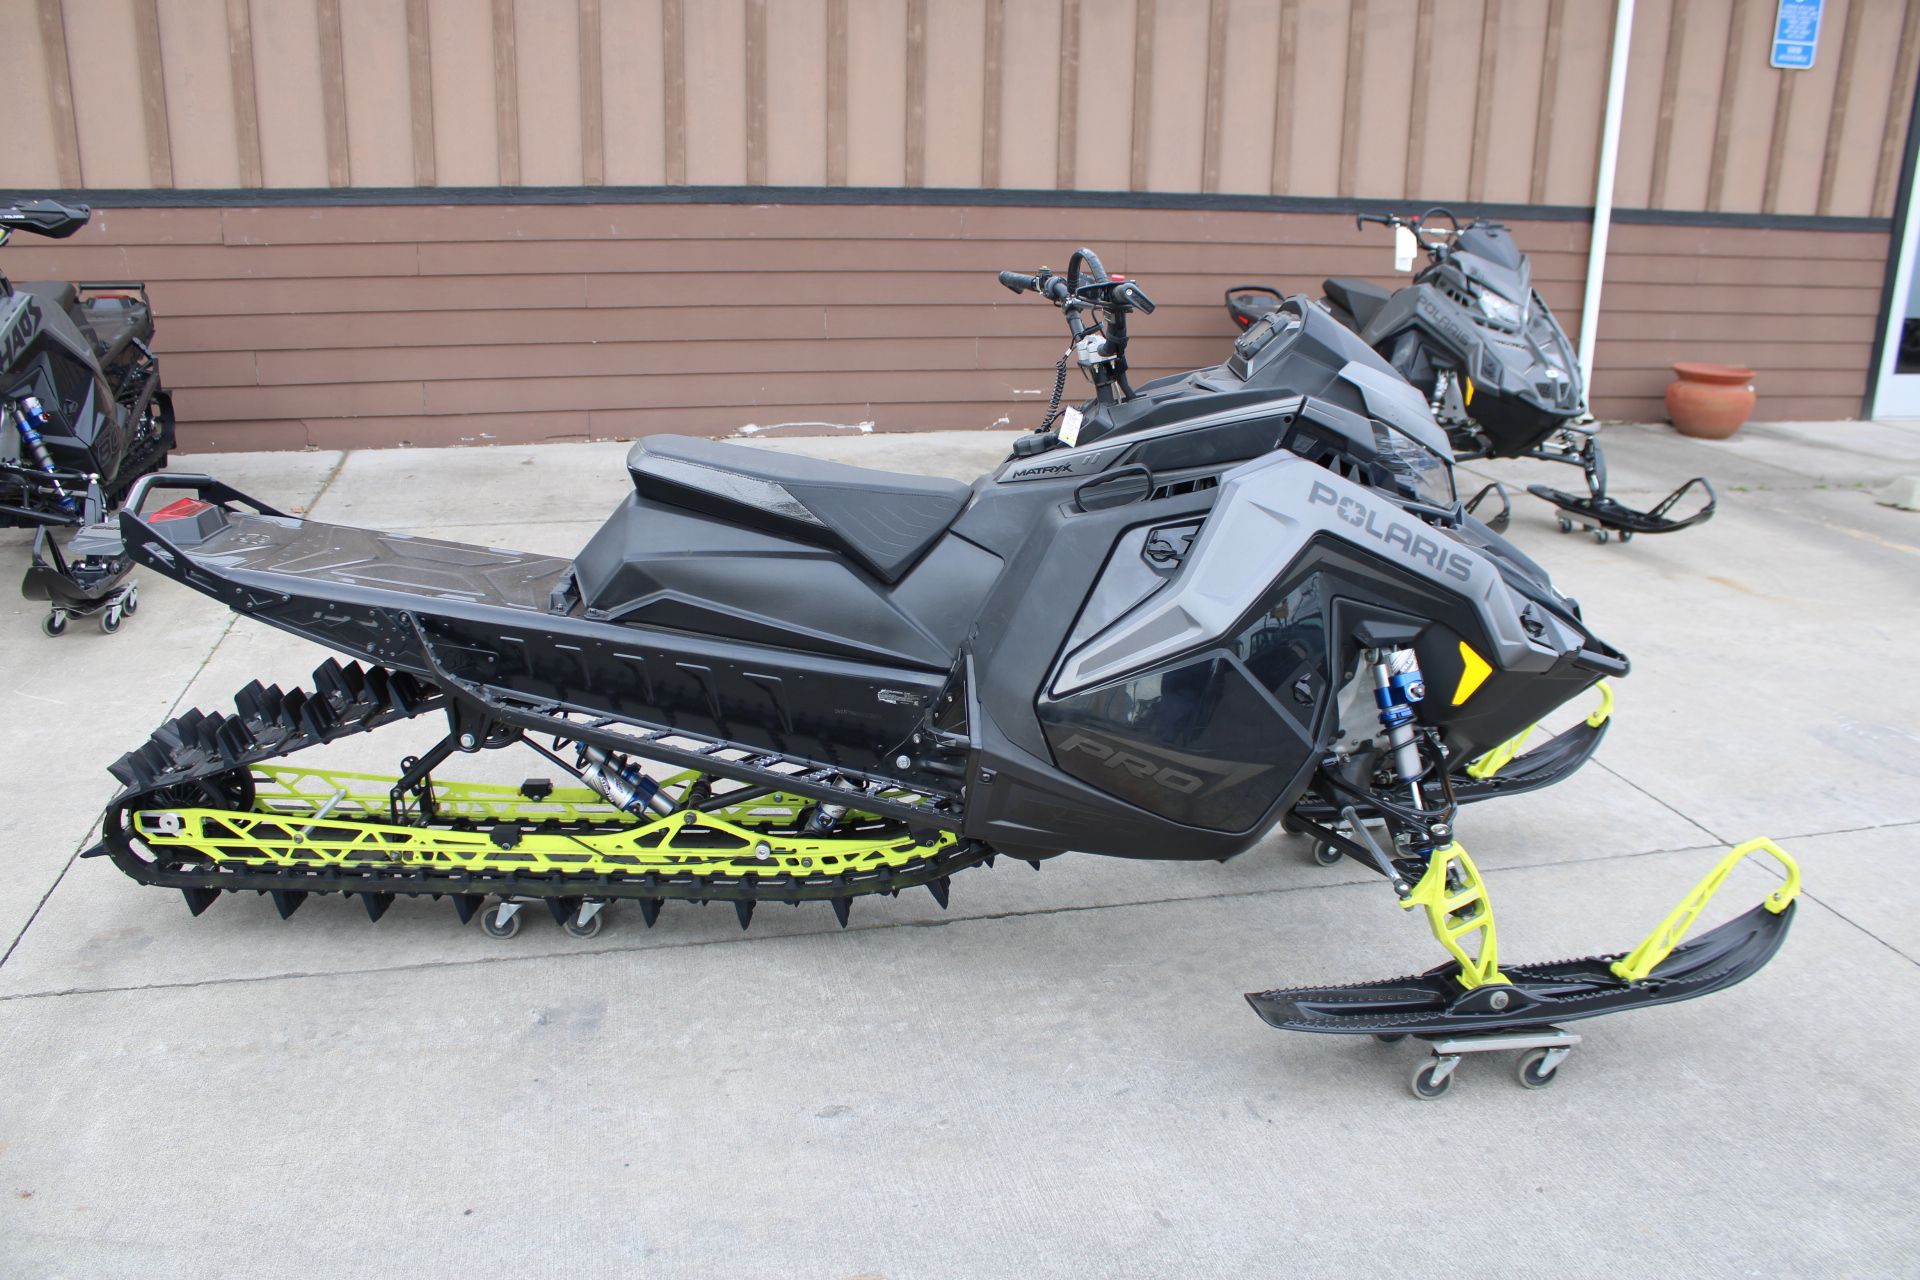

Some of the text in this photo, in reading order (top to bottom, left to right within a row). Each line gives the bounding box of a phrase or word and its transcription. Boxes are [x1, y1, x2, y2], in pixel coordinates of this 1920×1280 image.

[1416, 295, 1472, 347] POLARIS
[1012, 461, 1074, 479] MATRYX
[1308, 480, 1473, 582] POLARIS
[1057, 733, 1205, 795] PRO
